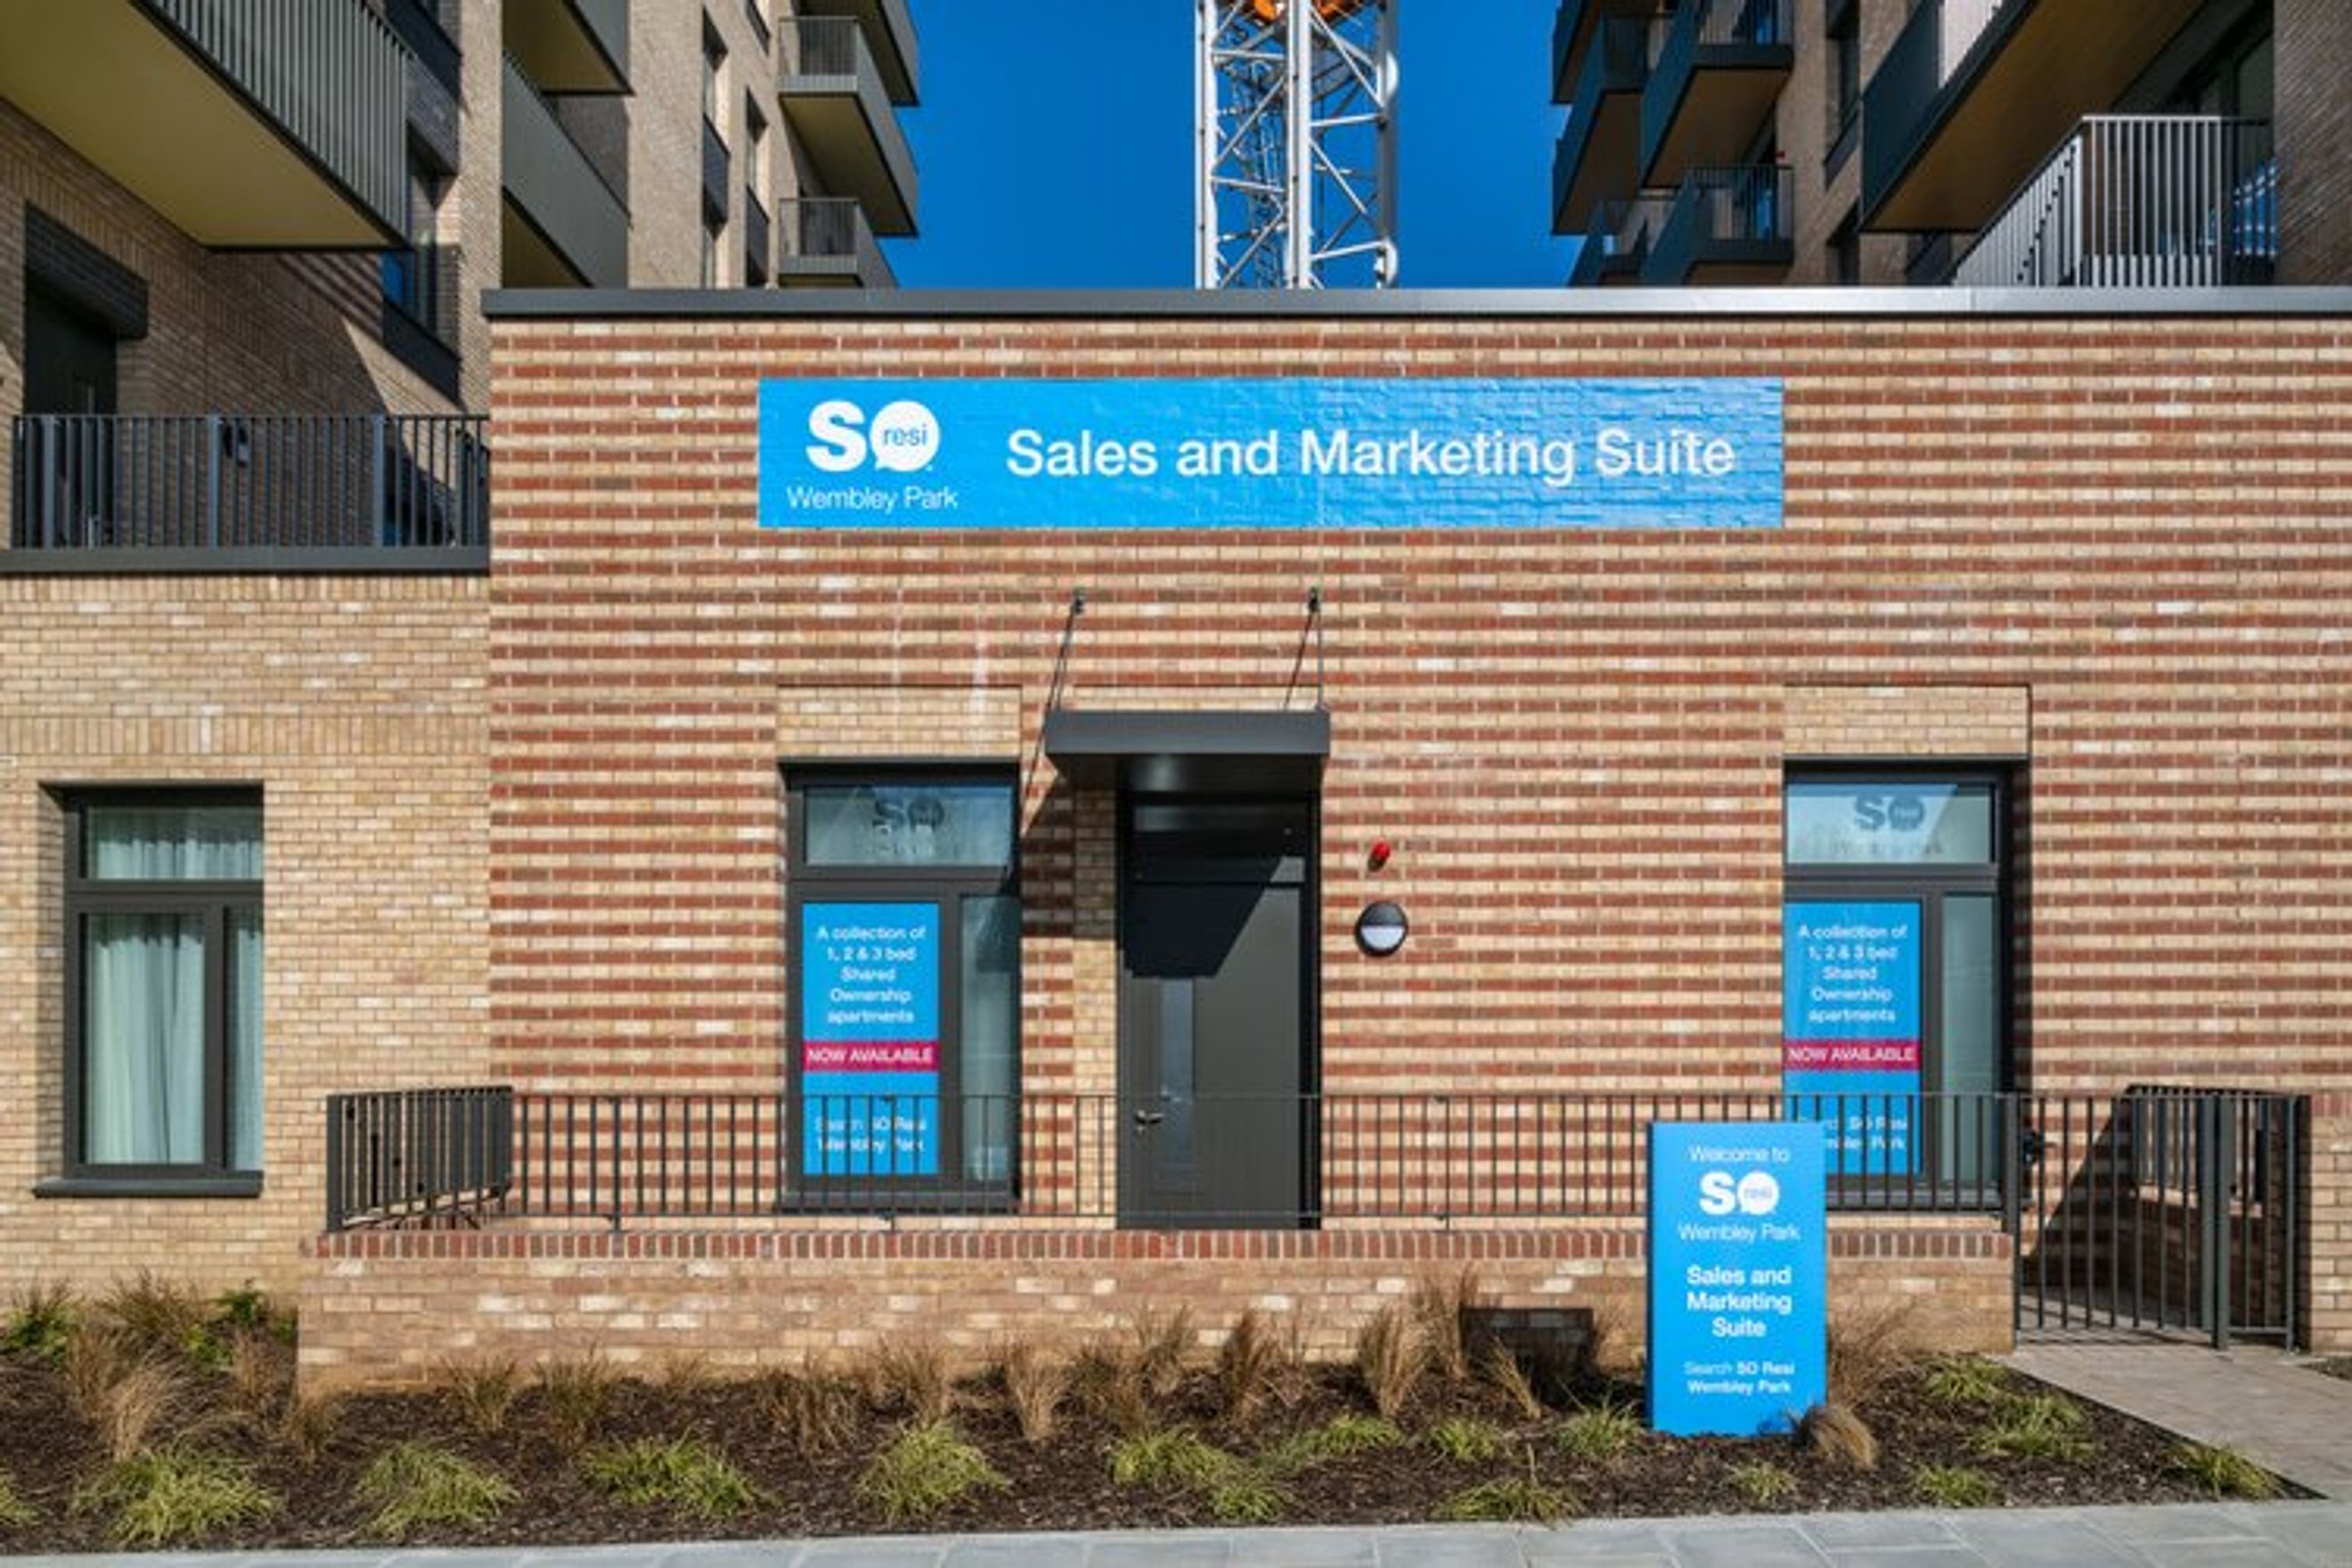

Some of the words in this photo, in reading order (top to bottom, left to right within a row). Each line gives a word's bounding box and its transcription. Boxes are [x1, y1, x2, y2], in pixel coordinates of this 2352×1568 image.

[883, 423, 928, 445] resi
[1007, 429, 1157, 477] Sales
[1177, 429, 1278, 477] and
[1301, 429, 1573, 486] Marketing
[1595, 428, 1735, 477] Suite
[787, 486, 898, 514] Wembley
[904, 486, 958, 509] Park
[817, 925, 829, 940] A
[832, 926, 906, 940] collection
[910, 926, 927, 939] of
[1799, 924, 1809, 938] A
[1812, 925, 1888, 939] collection
[1891, 924, 1907, 939] of
[844, 946, 853, 960] 2
[857, 946, 869, 960] &
[872, 946, 882, 960] 3
[885, 946, 917, 960] bed
[1825, 944, 1835, 960] 2
[1838, 944, 1850, 960] &
[1854, 944, 1864, 960] 3
[1867, 945, 1899, 960] bed
[841, 966, 895, 982] Shared
[1823, 965, 1877, 980] Shared
[829, 987, 912, 1004] Ownership
[1810, 985, 1893, 1003] Ownership
[828, 1009, 914, 1025] apartments
[1809, 1009, 1896, 1024] apartments
[807, 1047, 846, 1062] NOW
[850, 1047, 933, 1064] AVAILABLE
[1787, 1046, 1827, 1061] NOW
[1831, 1046, 1914, 1062] AVAILABLE
[1687, 1144, 1768, 1162] Welcome
[1771, 1146, 1790, 1162] to
[1678, 1223, 1757, 1244] Wembley
[1762, 1223, 1799, 1240] Park
[1687, 1264, 1745, 1286] Sales
[1751, 1264, 1792, 1286] and
[1687, 1292, 1792, 1315] Marketing
[1711, 1317, 1767, 1337] Suite
[1684, 1360, 1733, 1376] Search
[1737, 1360, 1759, 1376] SO
[1762, 1360, 1794, 1376] Resi
[1687, 1379, 1754, 1396] Wembley
[1758, 1379, 1792, 1393] Park
